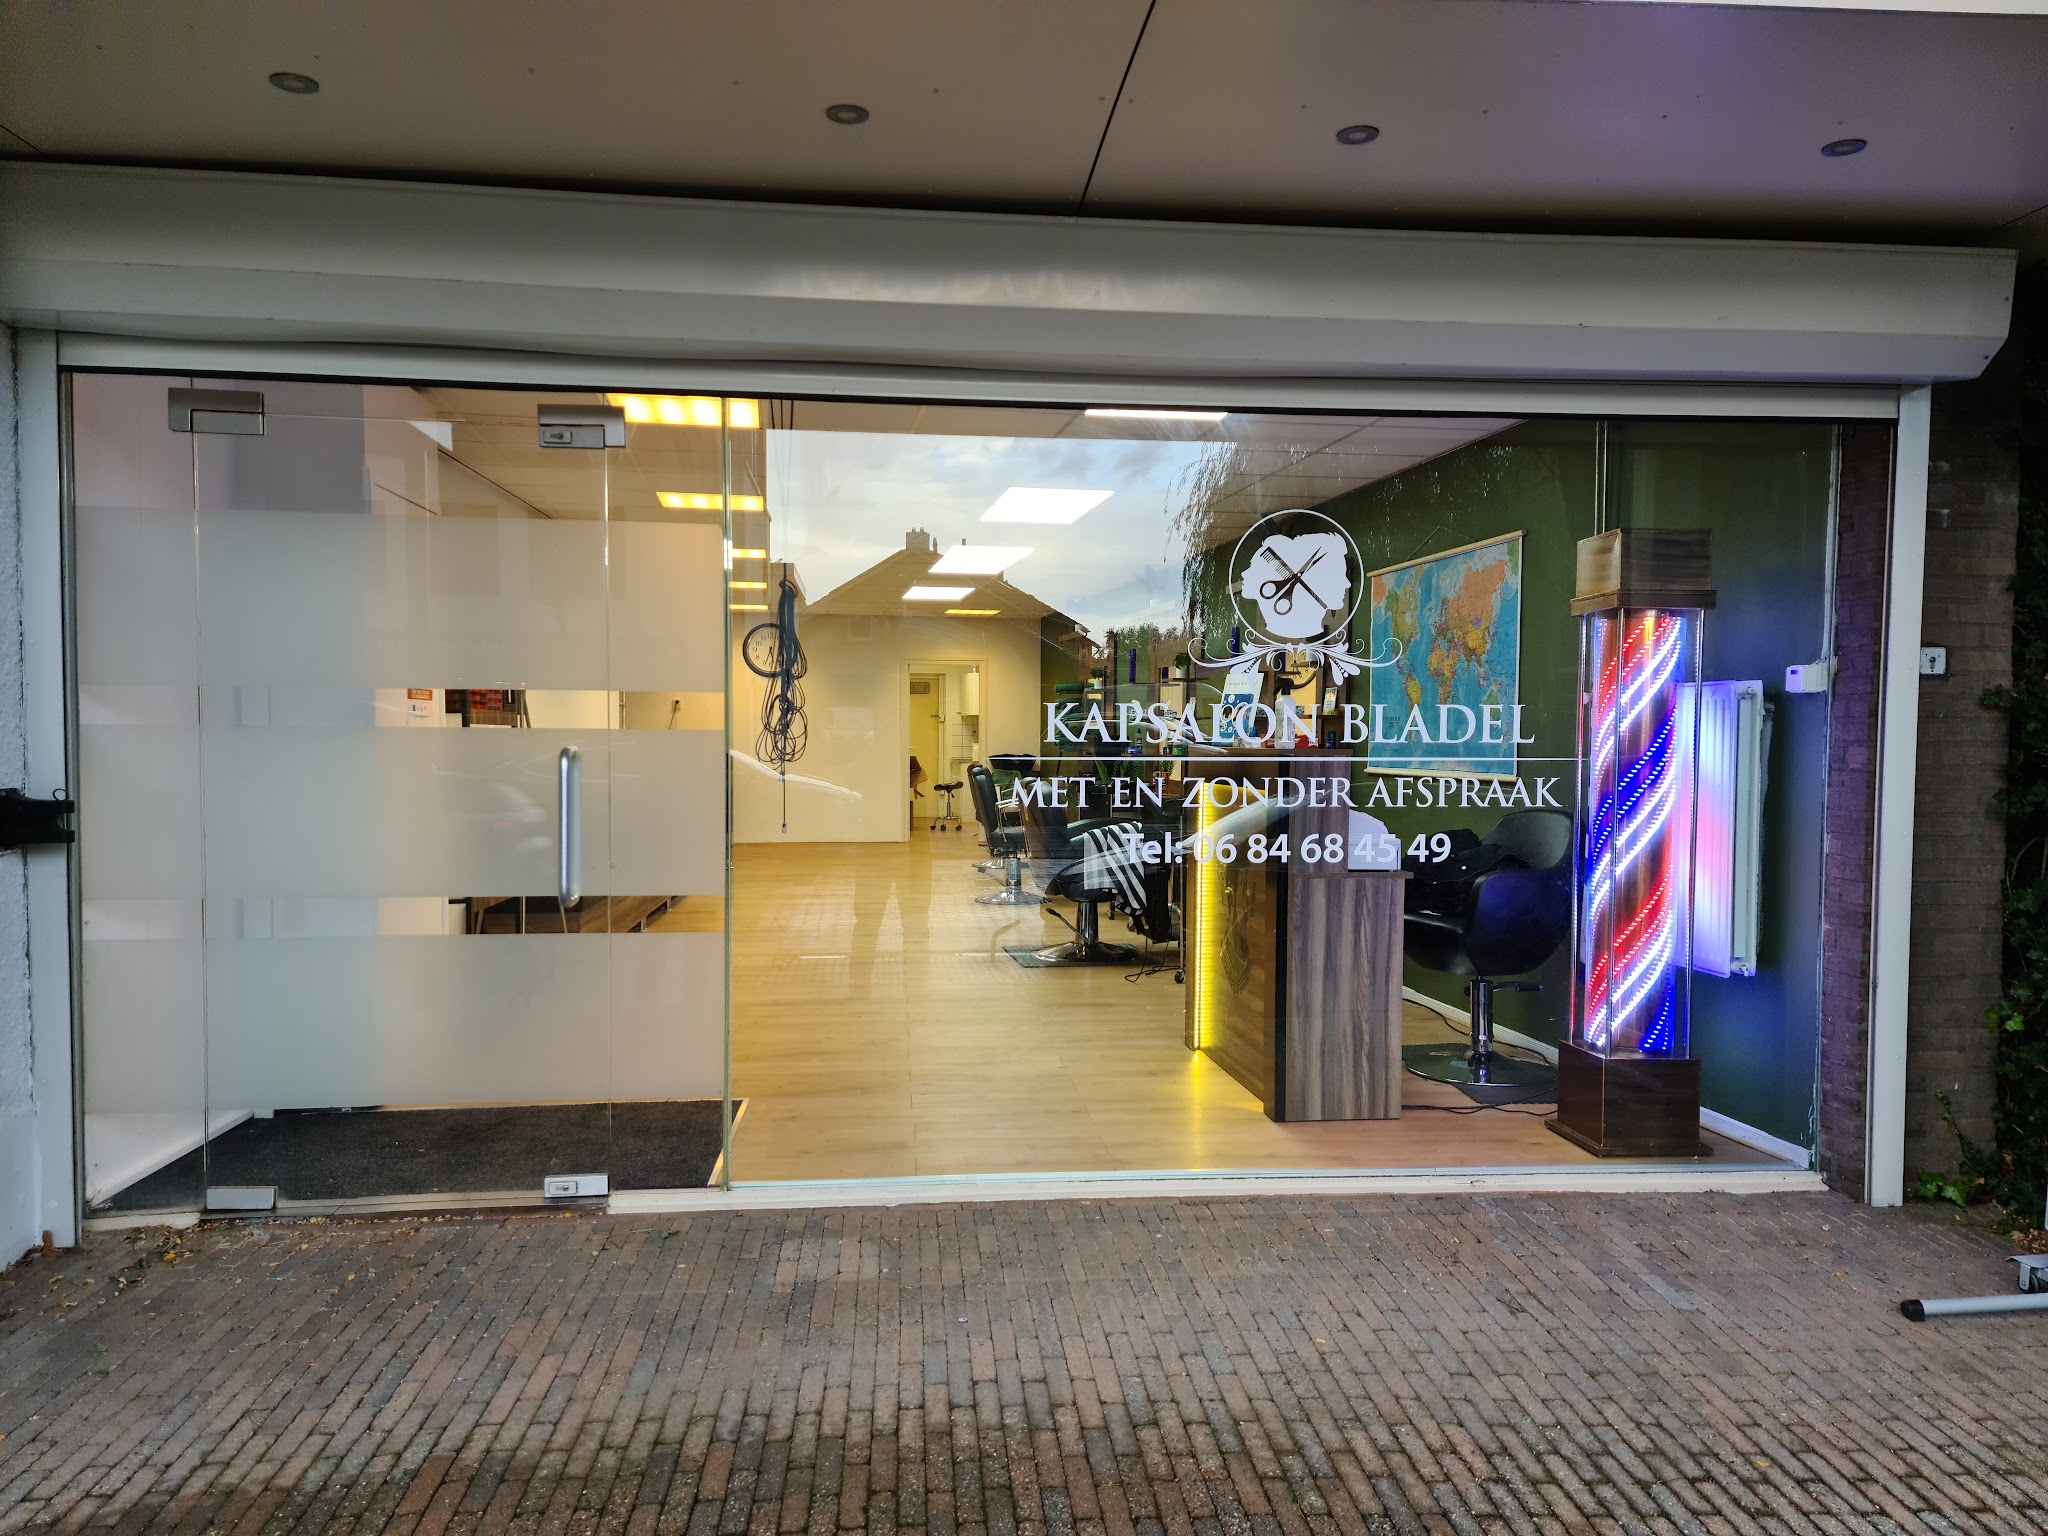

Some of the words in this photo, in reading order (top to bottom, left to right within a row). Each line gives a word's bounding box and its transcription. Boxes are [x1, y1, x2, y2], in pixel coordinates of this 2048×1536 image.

[1042, 702, 1321, 744] KAPSALON
[1340, 703, 1535, 744] BLADEL
[1009, 777, 1095, 808] MET
[1110, 777, 1163, 808] EN
[1182, 777, 1358, 808] ZONDER
[1365, 776, 1563, 808] AFSPRAAK
[1122, 832, 1182, 864] Tel:
[1193, 833, 1237, 864] 06
[1247, 833, 1291, 864] 84
[1301, 833, 1344, 864] 68
[1354, 833, 1397, 863] 45
[1407, 833, 1451, 863] 49
